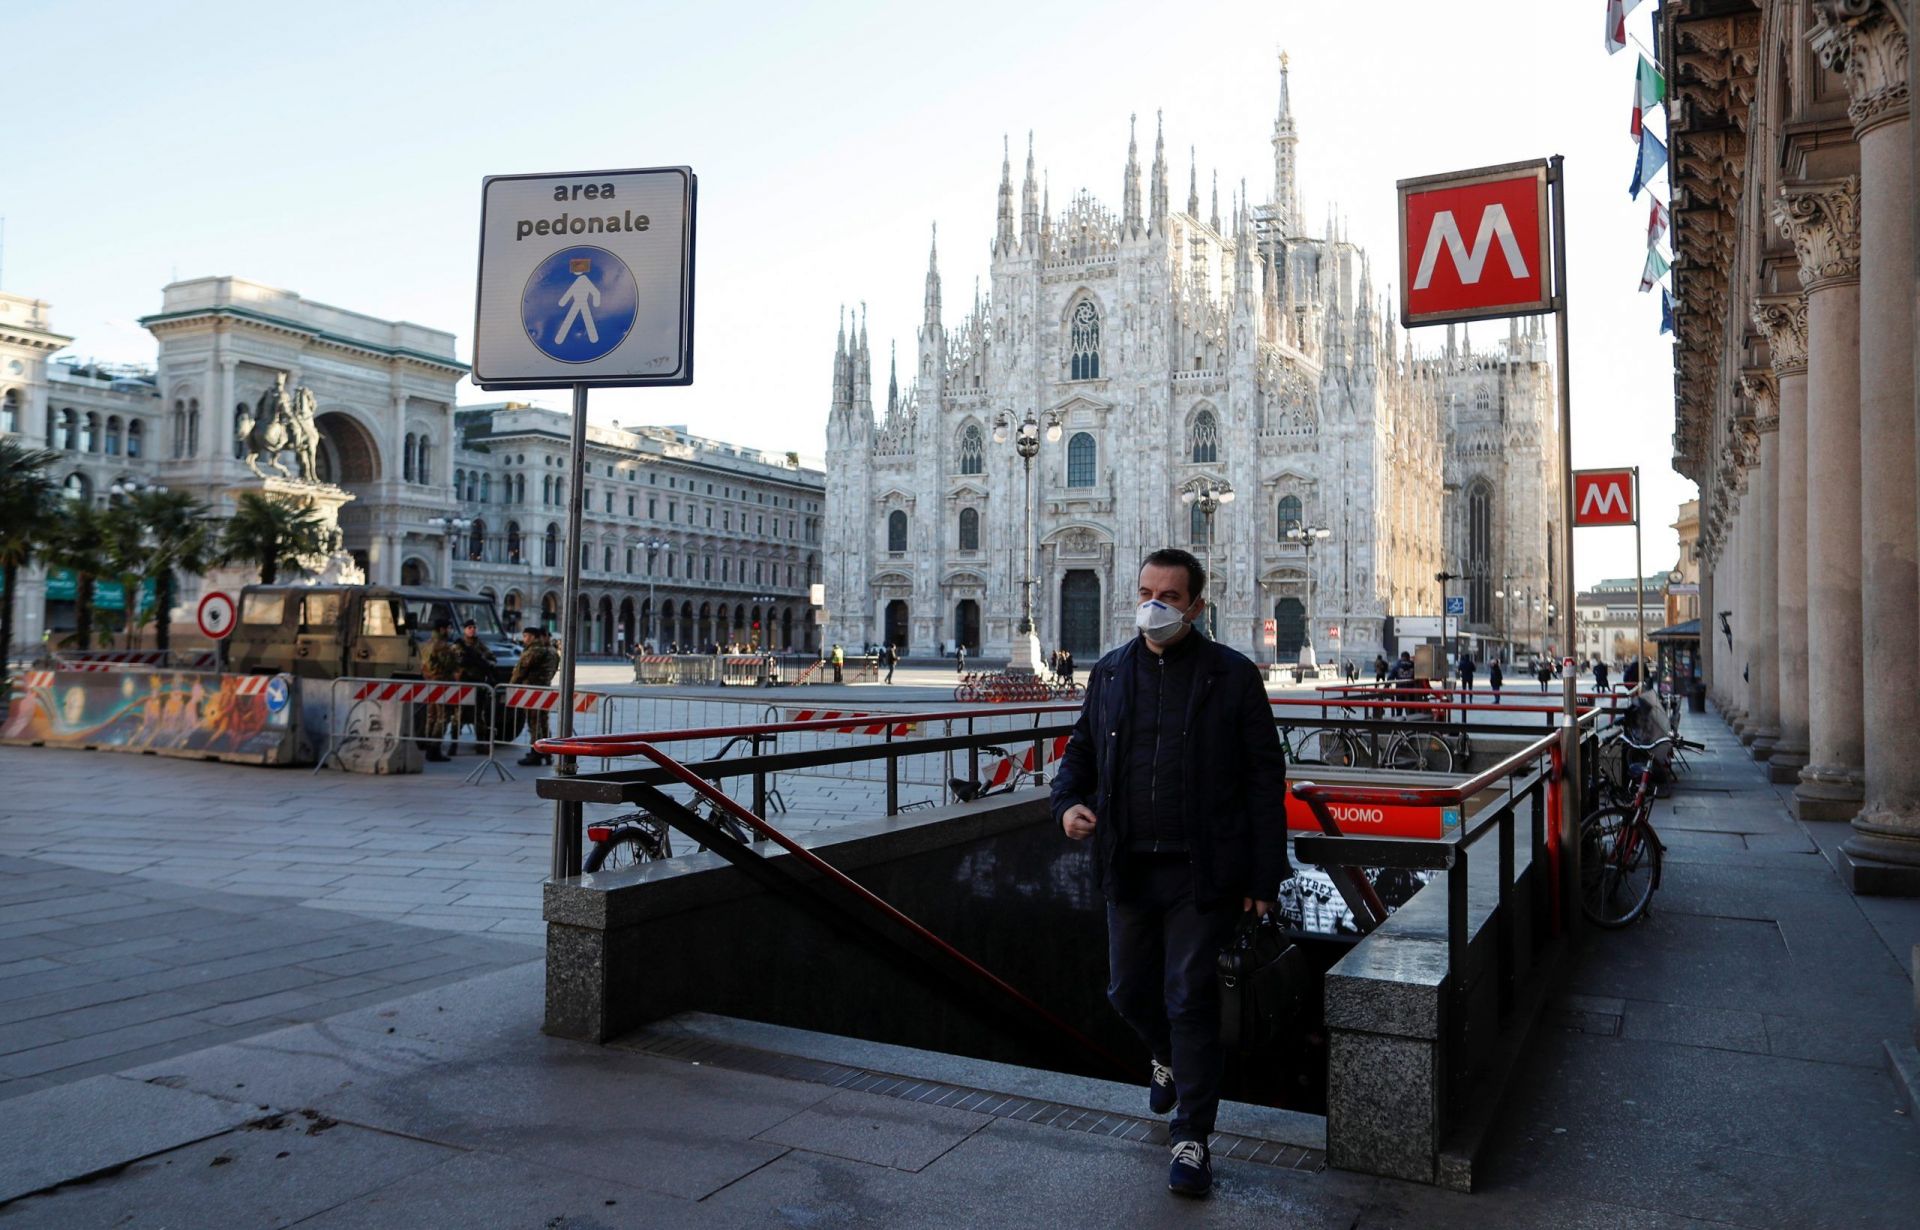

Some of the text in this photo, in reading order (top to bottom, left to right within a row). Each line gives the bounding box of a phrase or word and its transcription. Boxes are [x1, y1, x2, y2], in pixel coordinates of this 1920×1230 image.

[553, 182, 616, 201] area
[516, 210, 650, 241] pedonale
[1412, 203, 1531, 290] M
[1580, 482, 1629, 516] M
[1328, 806, 1384, 823] DUOMO
[1300, 876, 1335, 897] PYREX
